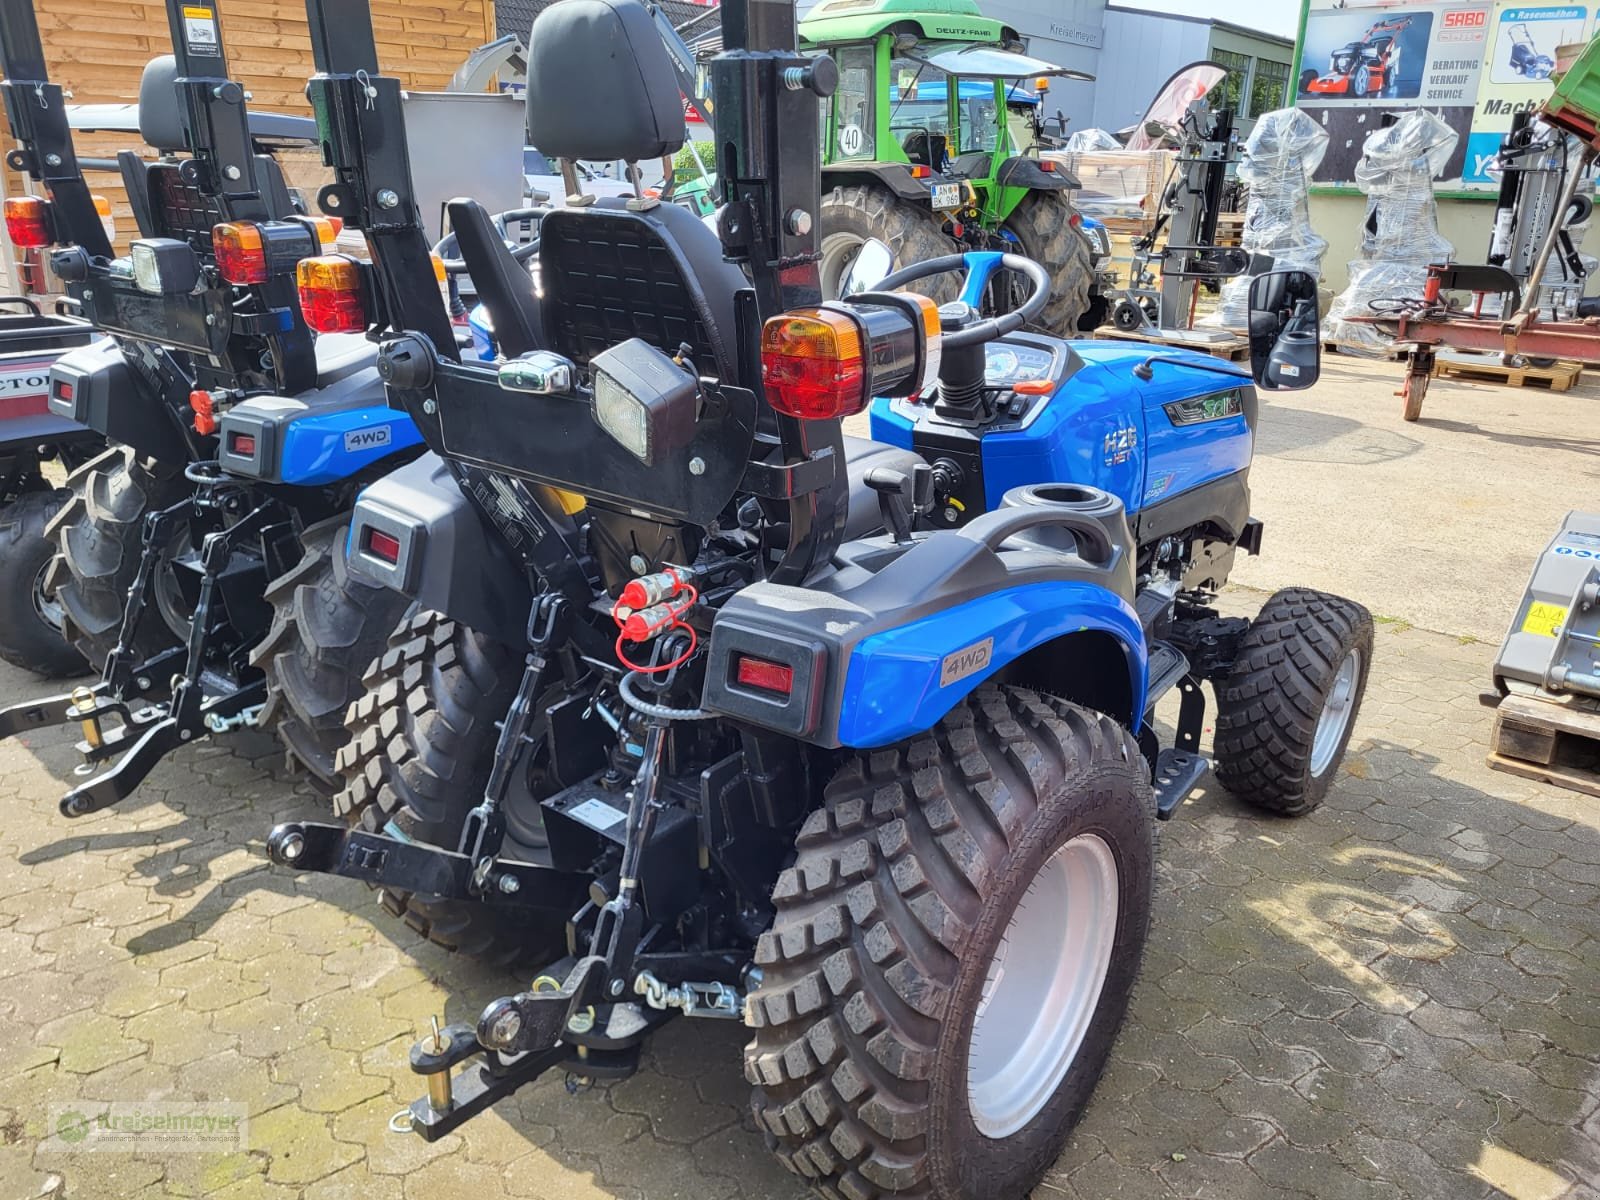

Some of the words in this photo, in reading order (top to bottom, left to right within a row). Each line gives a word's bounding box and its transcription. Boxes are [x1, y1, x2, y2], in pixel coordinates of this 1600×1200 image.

[1444, 12, 1485, 27] SABO
[935, 27, 991, 36] DEUTZ-FAHR
[1050, 23, 1097, 42] Kreiselmeyer
[1432, 60, 1478, 70] BERATUNG
[1430, 75, 1469, 85] VERKAUF
[1427, 90, 1463, 99] SERVICE
[845, 129, 858, 150] 40
[350, 430, 387, 446] 4WD
[946, 646, 987, 675] 4WD
